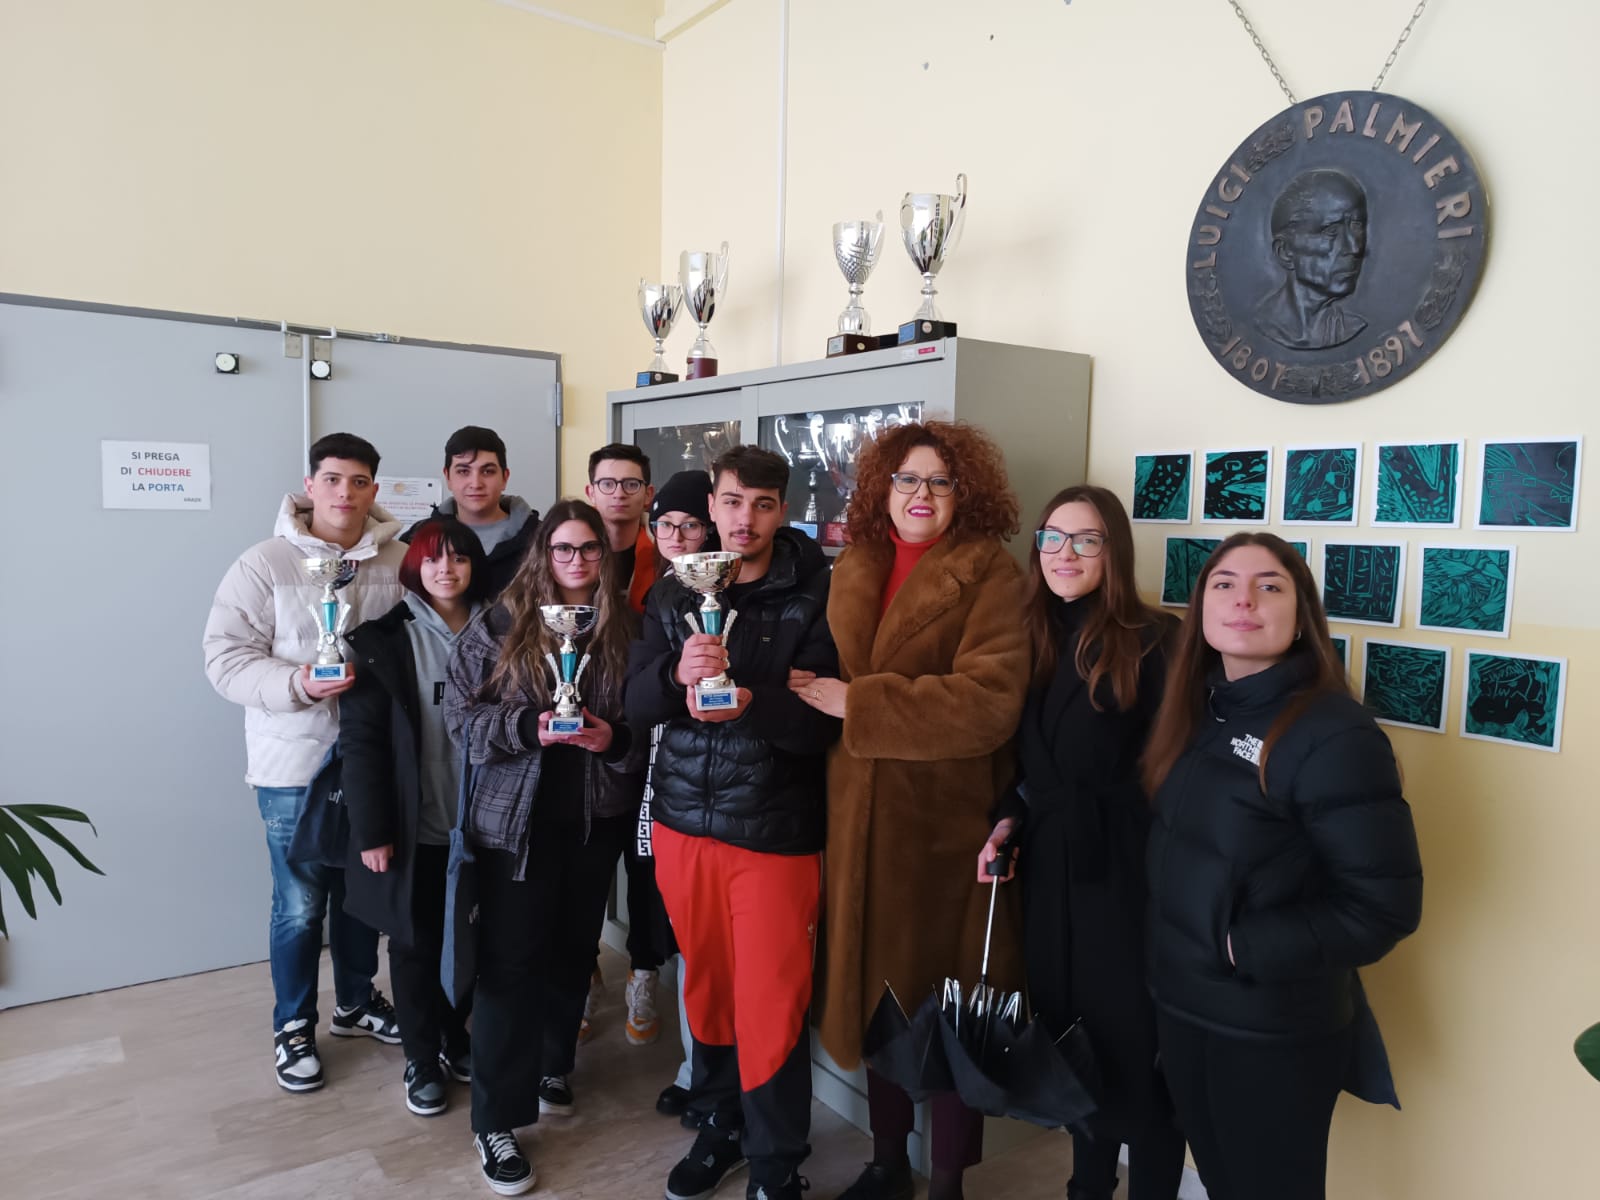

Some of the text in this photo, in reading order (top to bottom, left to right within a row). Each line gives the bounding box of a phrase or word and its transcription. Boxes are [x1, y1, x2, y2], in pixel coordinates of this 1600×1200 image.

[1193, 100, 1473, 269] LUIGI PALMIERI
[1221, 320, 1423, 390] 1807 1897
[131, 451, 180, 461] SI PREGA
[120, 466, 192, 477] DI CHIUDERE
[132, 482, 184, 492] LA PORTA
[1230, 737, 1256, 753] NORTH
[1244, 734, 1258, 746] THE
[1233, 746, 1254, 761] FACE
